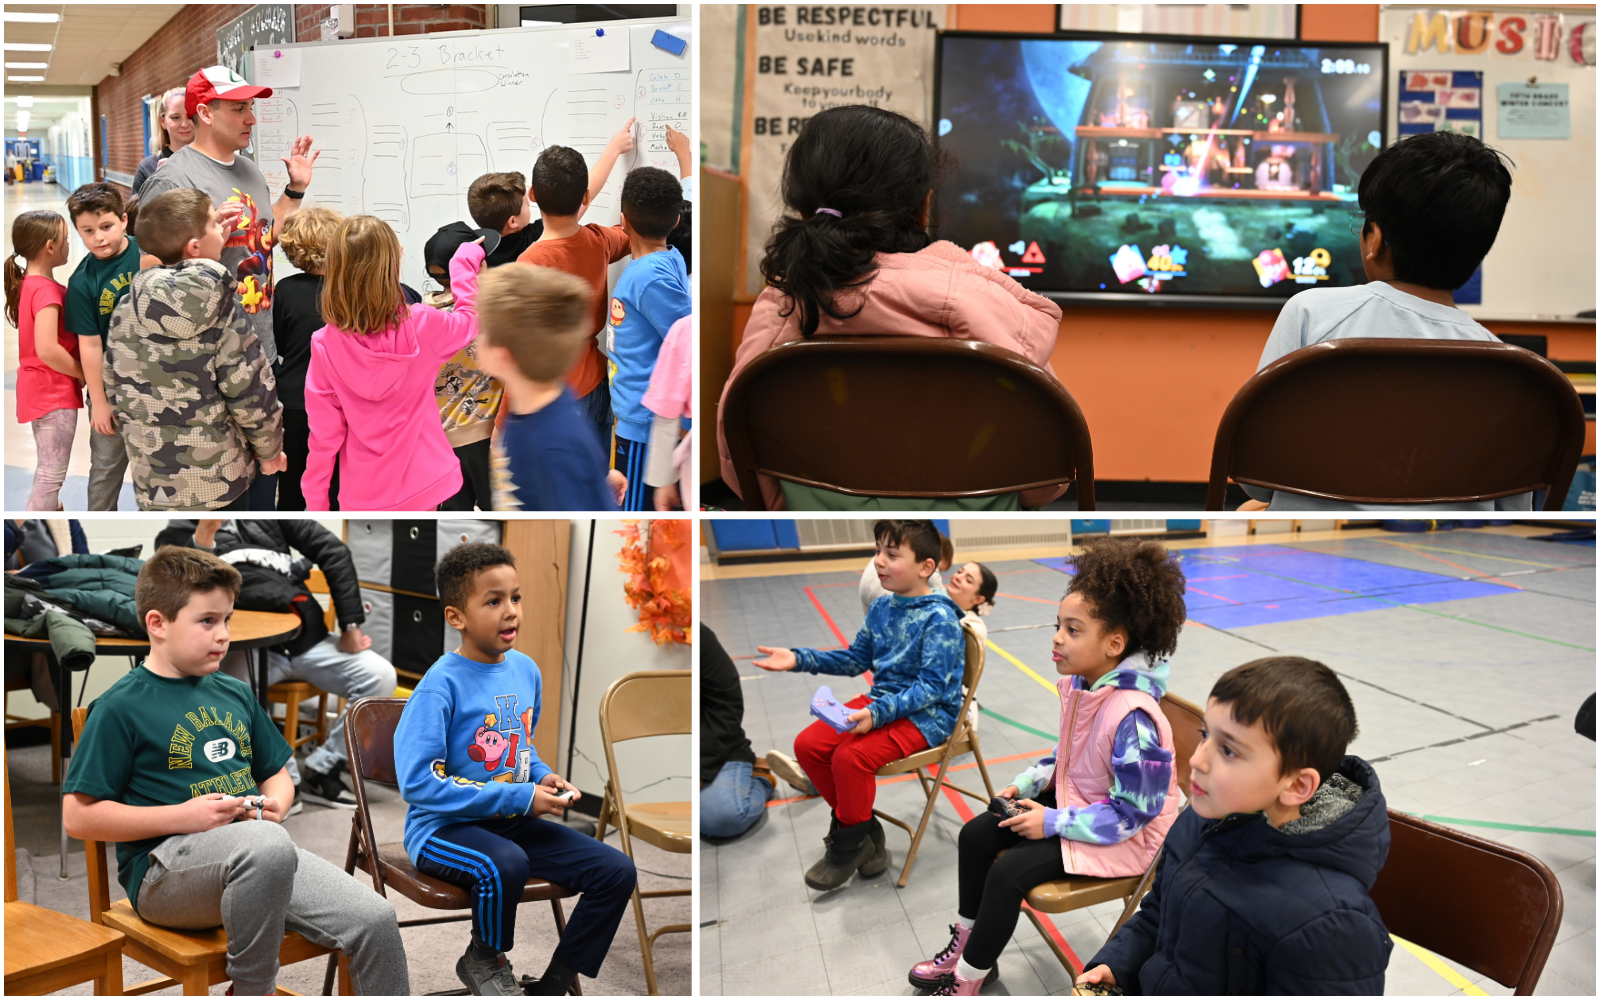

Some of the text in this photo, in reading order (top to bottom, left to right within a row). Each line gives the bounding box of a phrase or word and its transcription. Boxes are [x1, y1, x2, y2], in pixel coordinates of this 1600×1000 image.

[758, 7, 938, 29] BE RESPECTFUL
[784, 29, 906, 46] Use kind words
[386, 44, 505, 69] 2-3 Bracket
[759, 56, 854, 77] BE SAFE
[784, 84, 892, 100] Keep your body
[755, 117, 782, 136] BE
[168, 724, 196, 770] NEW
